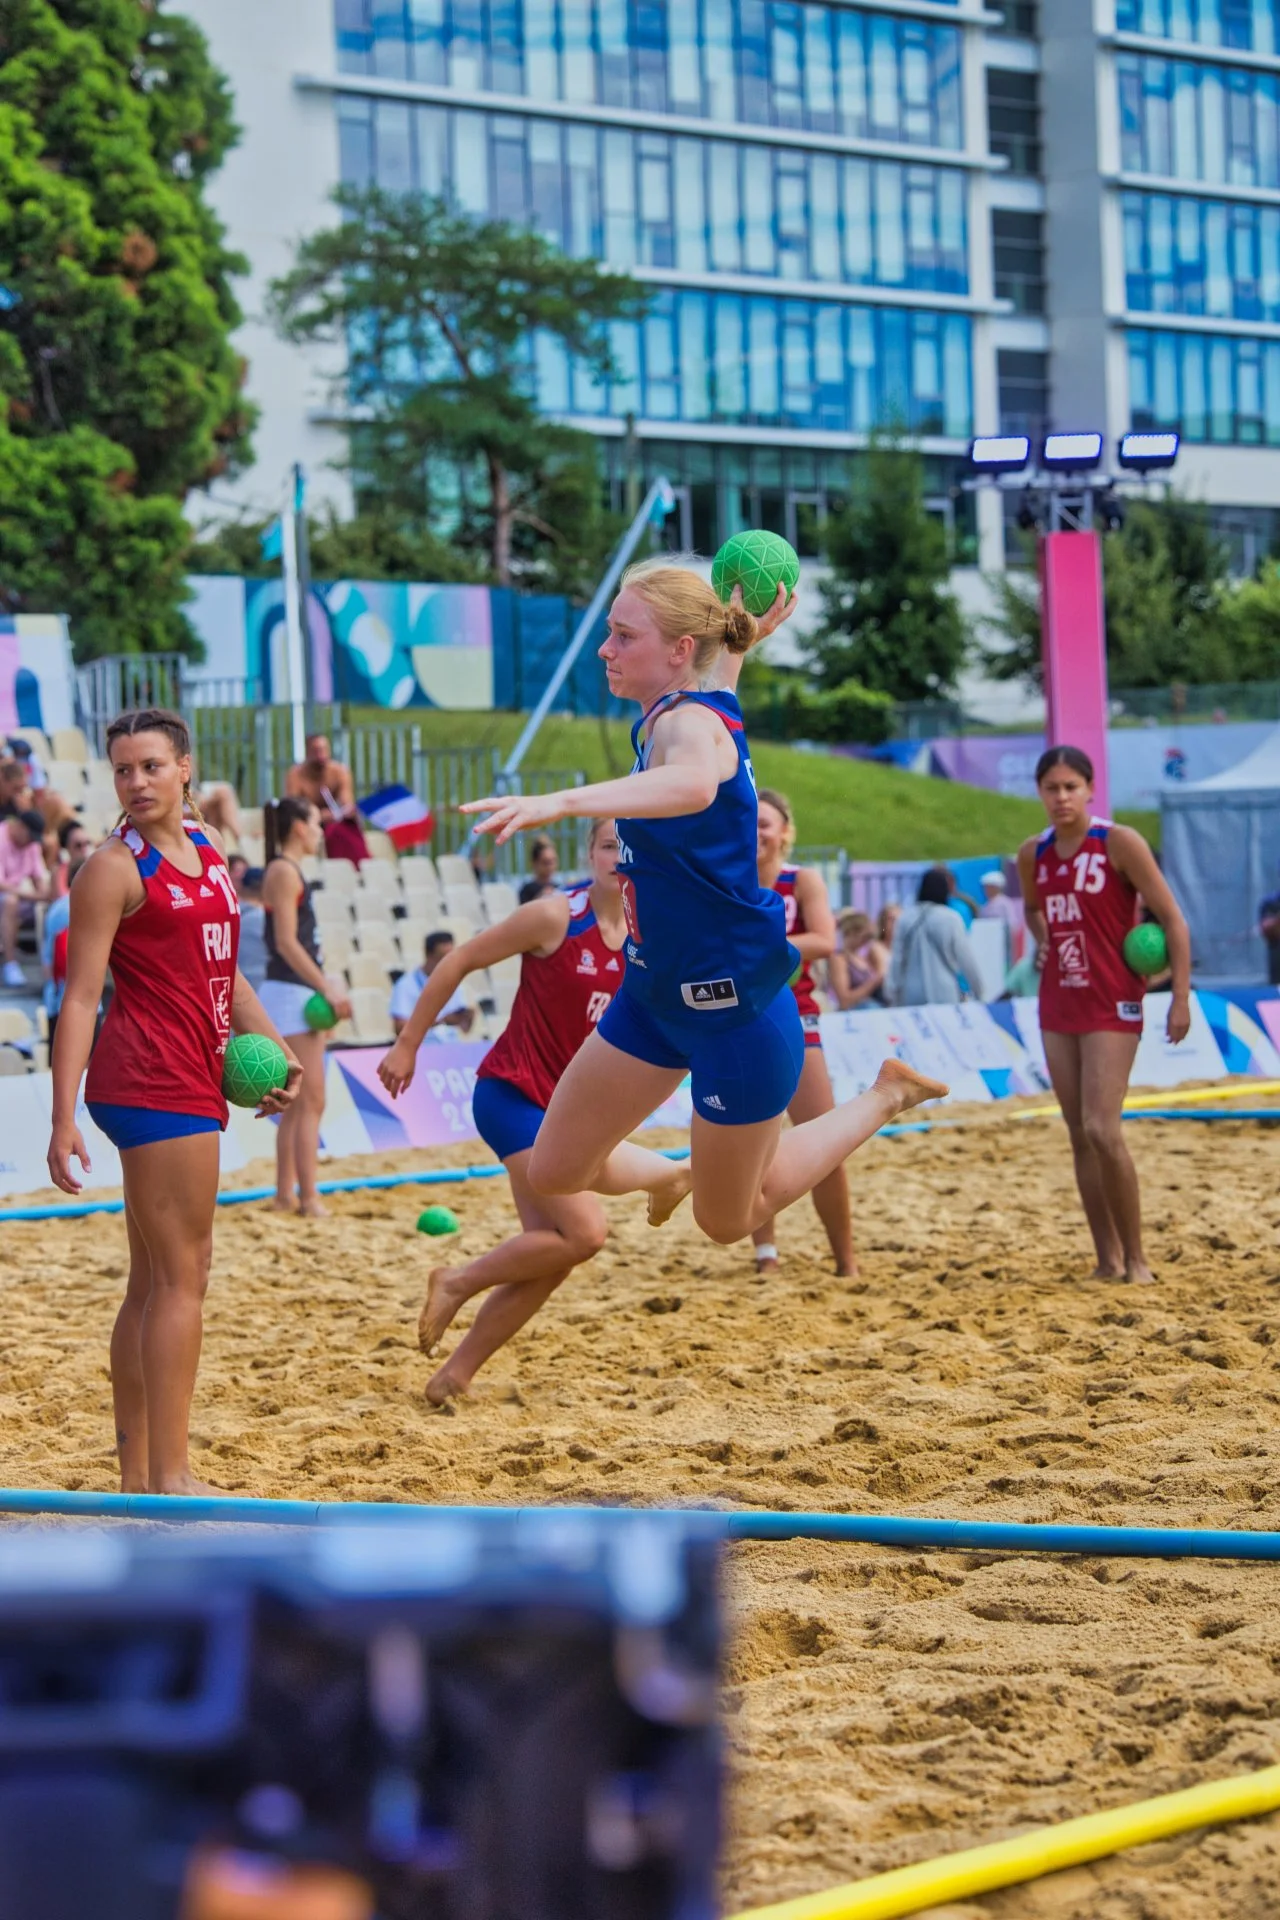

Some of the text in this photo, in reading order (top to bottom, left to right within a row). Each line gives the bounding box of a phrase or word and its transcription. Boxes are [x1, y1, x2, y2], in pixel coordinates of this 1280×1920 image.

[1073, 852, 1106, 894] 15
[1046, 893, 1082, 922] FRA
[202, 921, 232, 961] FRA
